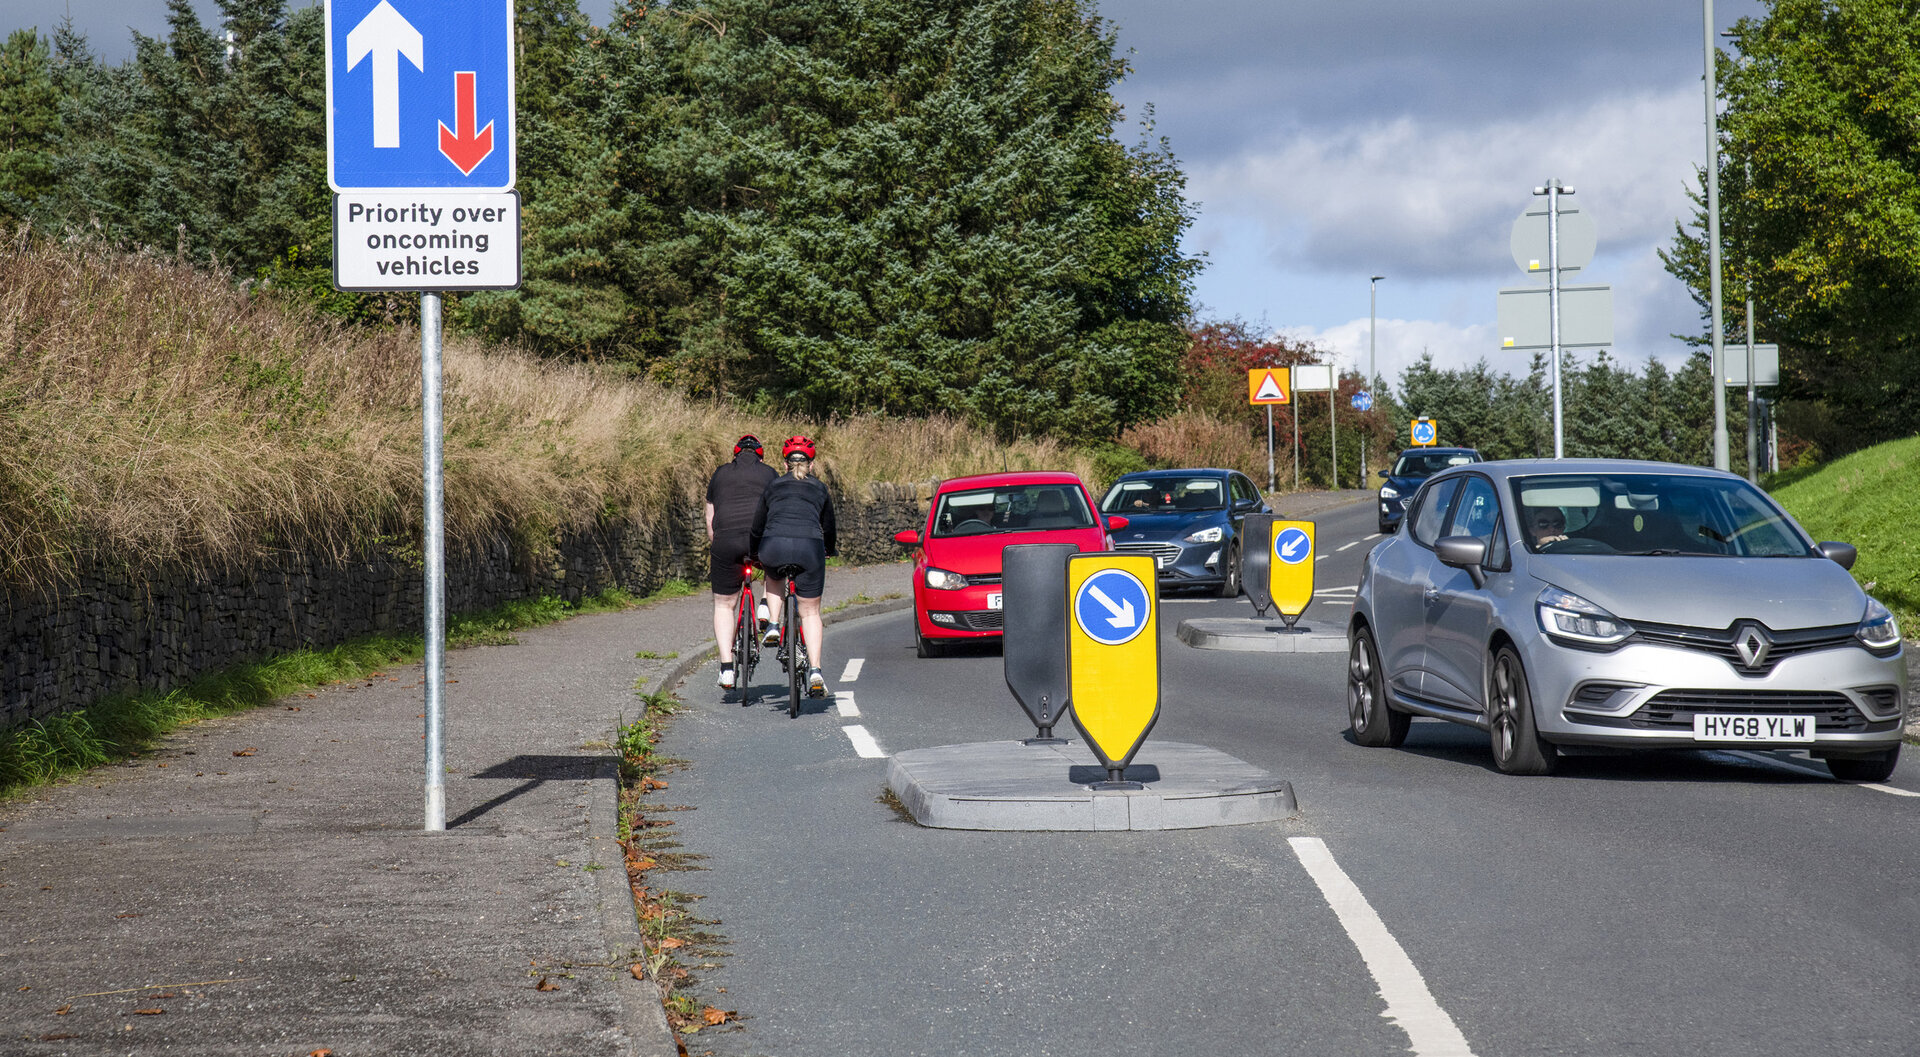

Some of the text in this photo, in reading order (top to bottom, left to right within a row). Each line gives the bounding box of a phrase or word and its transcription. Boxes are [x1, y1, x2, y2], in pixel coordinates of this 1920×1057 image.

[348, 203, 507, 226] Priority over
[367, 229, 489, 253] oncoming
[376, 255, 480, 276] vehicles
[1705, 717, 1805, 737] HY68 YLW
